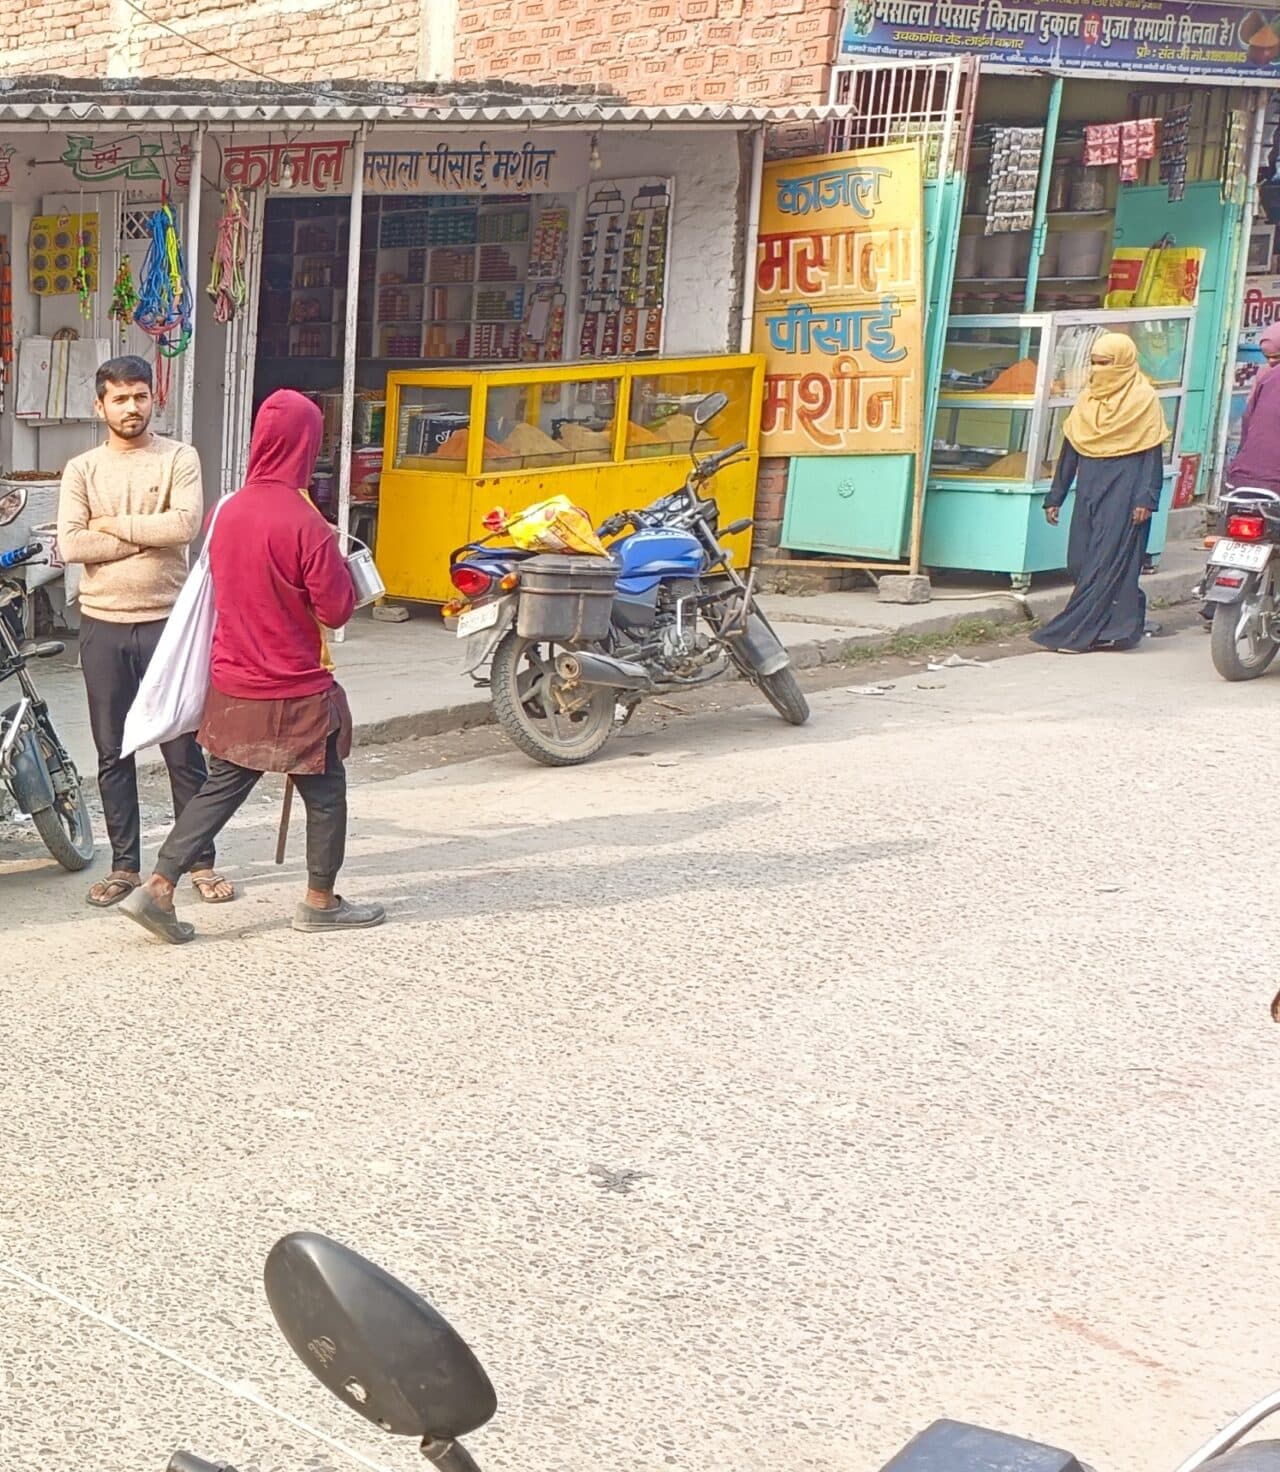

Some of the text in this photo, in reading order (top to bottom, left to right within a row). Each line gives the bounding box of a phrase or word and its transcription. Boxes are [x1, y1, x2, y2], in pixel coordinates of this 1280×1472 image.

[875, 0, 932, 26] मसाला
[934, 0, 984, 33] पिसाई
[985, 1, 1038, 33] किराना
[1038, 10, 1082, 43] दुकान
[1177, 15, 1219, 46] मिलता
[223, 140, 351, 191] काजल
[426, 141, 491, 189] पीसाई
[492, 142, 557, 188] मशीन
[776, 166, 893, 218] काजल
[756, 226, 916, 296] मसाला
[765, 297, 908, 362] पीसाई
[761, 354, 914, 449] मशीन
